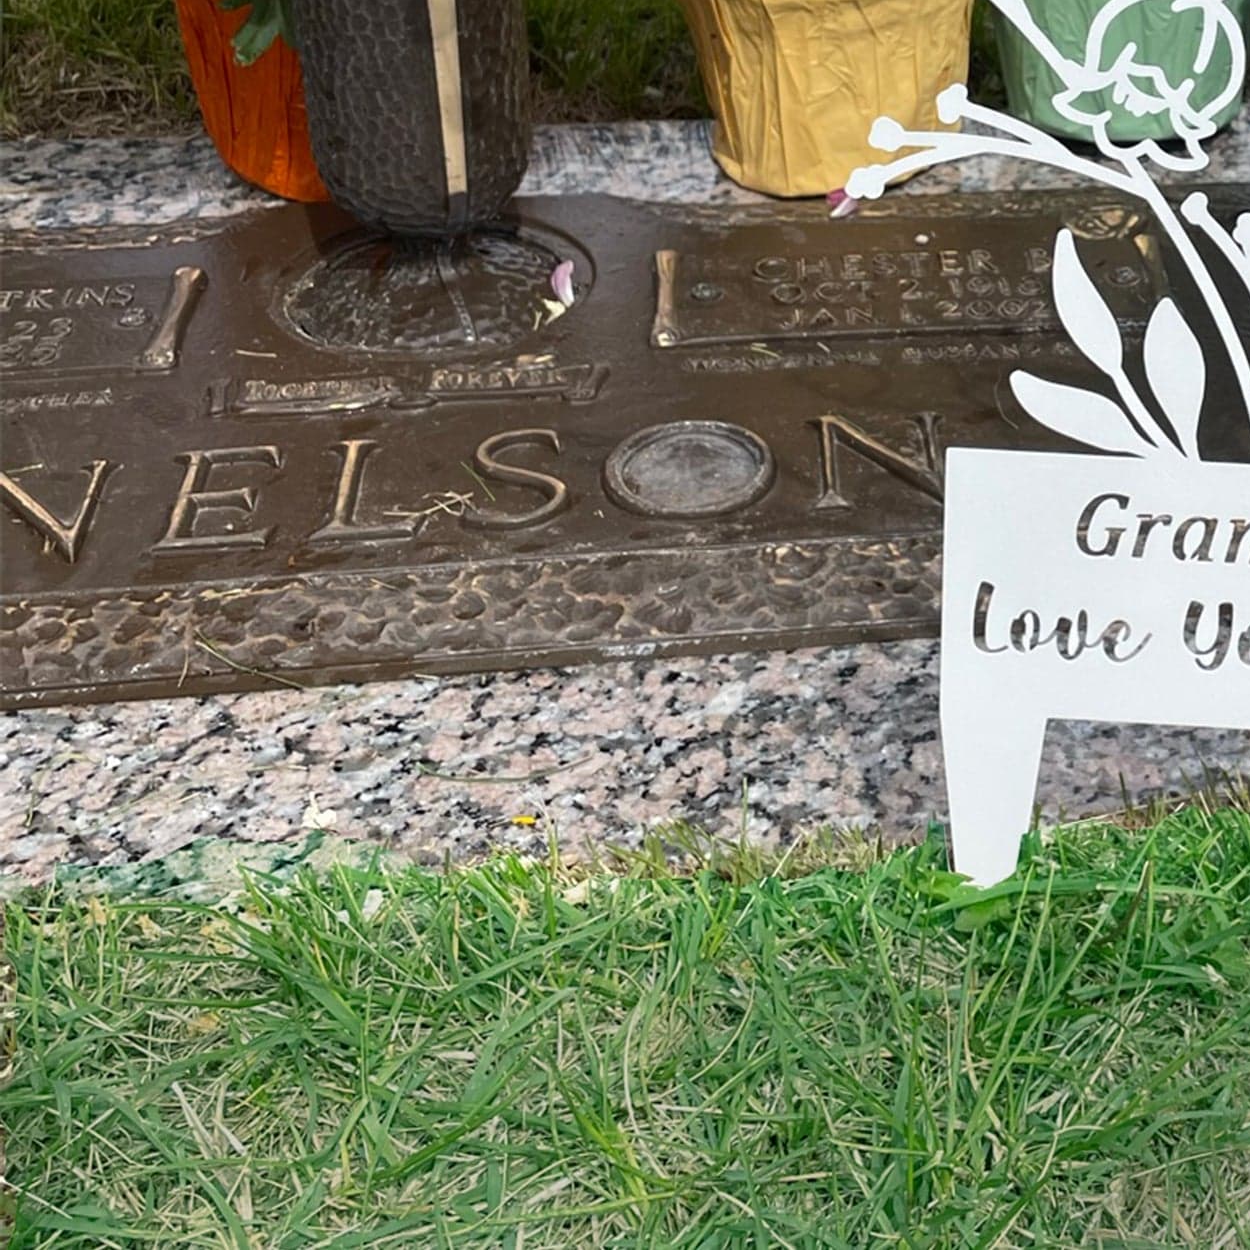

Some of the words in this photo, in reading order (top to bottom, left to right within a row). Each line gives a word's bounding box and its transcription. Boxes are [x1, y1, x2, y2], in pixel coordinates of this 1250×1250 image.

[752, 249, 998, 283] CHESTER
[430, 366, 568, 390] FOREVER
[972, 580, 1153, 663] Love
